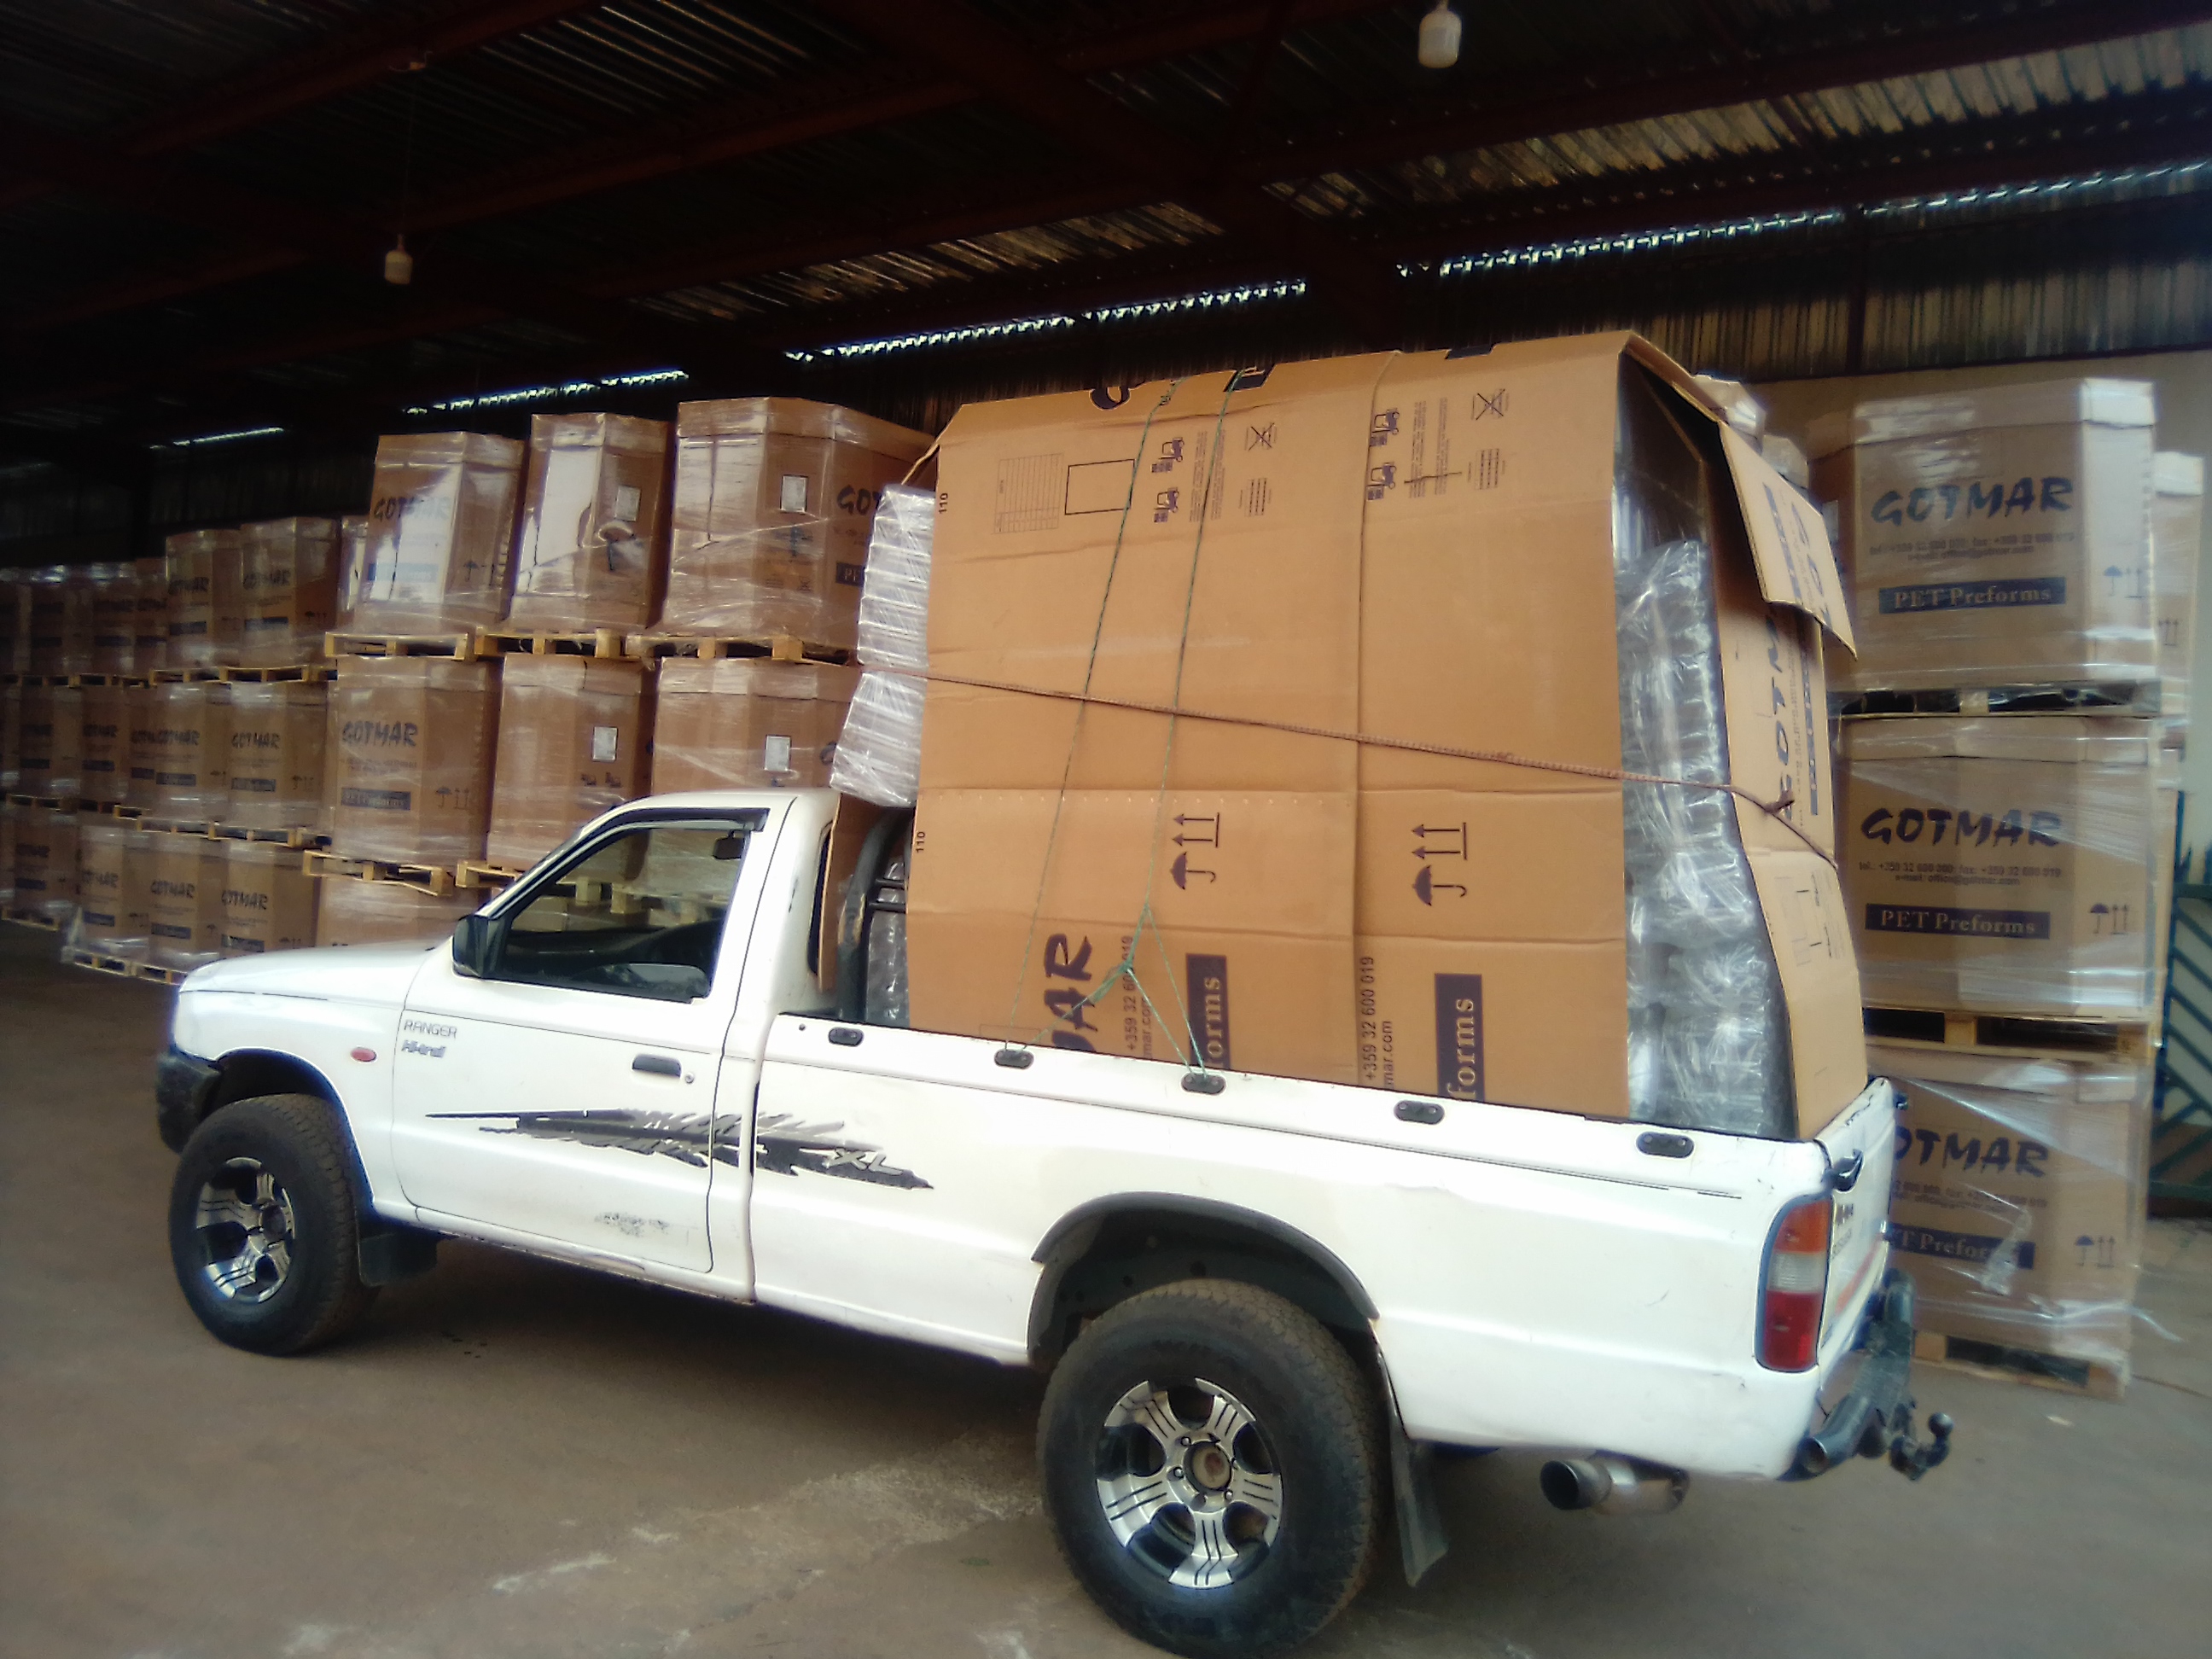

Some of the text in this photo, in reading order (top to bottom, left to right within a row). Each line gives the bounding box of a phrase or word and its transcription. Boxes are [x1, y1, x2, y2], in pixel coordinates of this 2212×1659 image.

[939, 492, 948, 514] 110
[1870, 476, 2074, 527] GOTMAR
[1895, 585, 2052, 608] PET Preforms
[343, 720, 418, 748] GOTMAR
[1860, 807, 2063, 847] GOTMAR
[916, 831, 925, 853] 110
[1881, 909, 2036, 935] PET Preforms
[1123, 995, 1137, 1014] 32
[404, 1019, 457, 1039] RANGER
[1359, 957, 1377, 1080] +359 32 600 019
[1894, 1126, 2048, 1178] OTMAR
